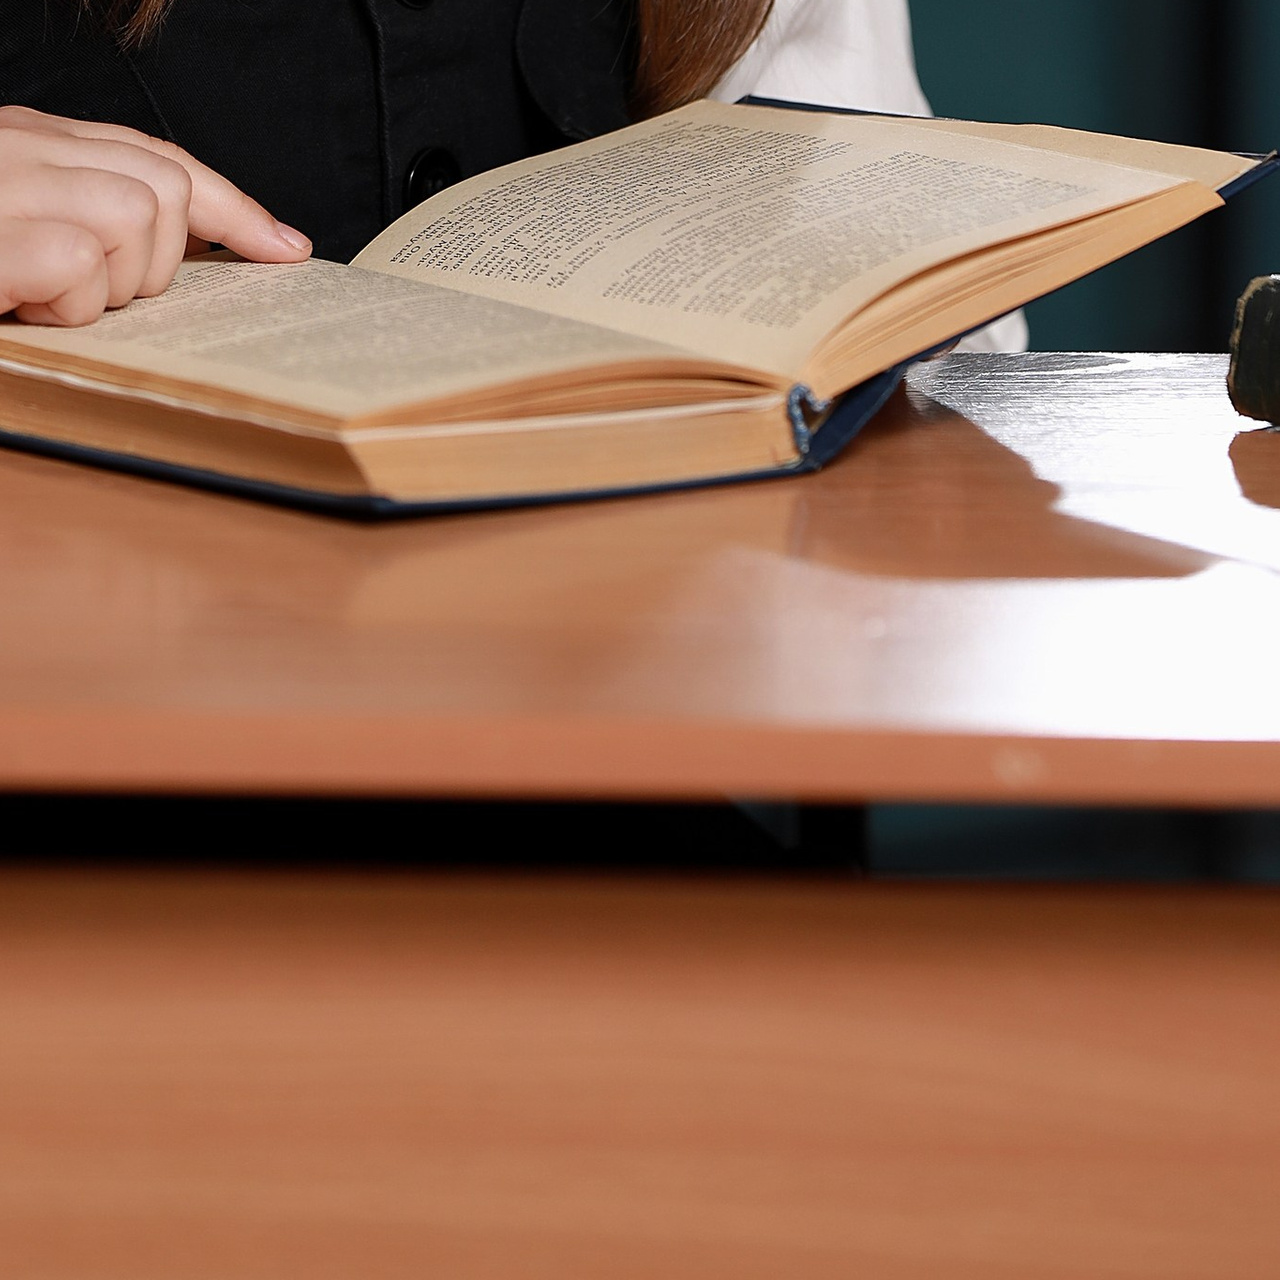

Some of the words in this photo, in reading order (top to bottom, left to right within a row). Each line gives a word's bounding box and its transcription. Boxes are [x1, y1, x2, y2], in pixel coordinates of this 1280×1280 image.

[389, 217, 448, 263] свыкнуться
[398, 246, 424, 264] Она
[413, 240, 449, 268] Муси-
[423, 234, 466, 268] Волохо-
[432, 233, 479, 270] болтали.
[448, 241, 488, 273] шумно.
